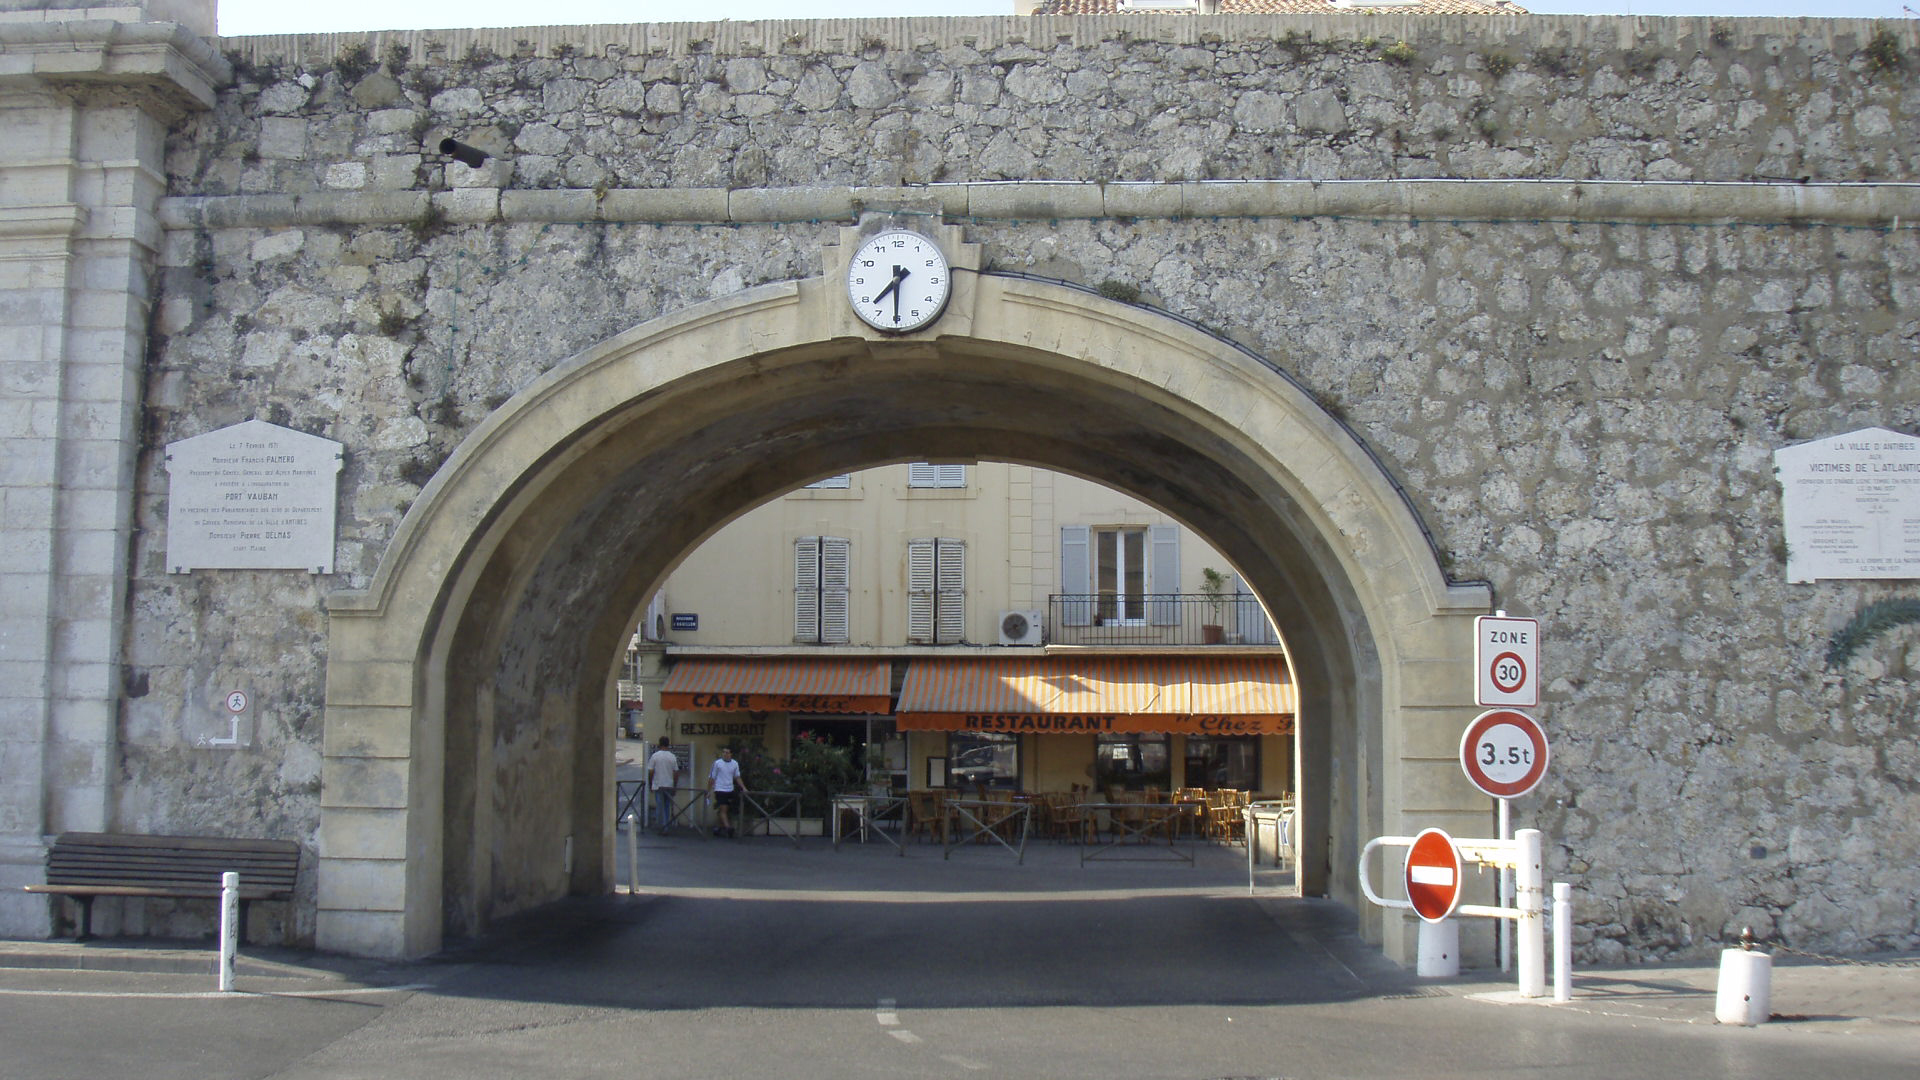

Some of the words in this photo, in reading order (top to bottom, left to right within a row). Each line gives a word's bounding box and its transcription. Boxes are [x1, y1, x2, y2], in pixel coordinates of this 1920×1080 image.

[1834, 443, 1845, 451] LA
[1848, 443, 1870, 451] VILLE
[266, 456, 294, 464] PALMERO
[1809, 463, 1850, 472] VICTIMES
[1855, 463, 1867, 472] DE
[225, 493, 242, 501] PORT
[248, 493, 278, 501] VAUBAN
[1490, 632, 1528, 644] ZONE
[1499, 665, 1519, 681] 30
[692, 694, 750, 708] CAFE
[965, 715, 1116, 729] RESTAURANT
[681, 723, 767, 736] RESTAURANT
[1481, 742, 1531, 765] 3.5t
